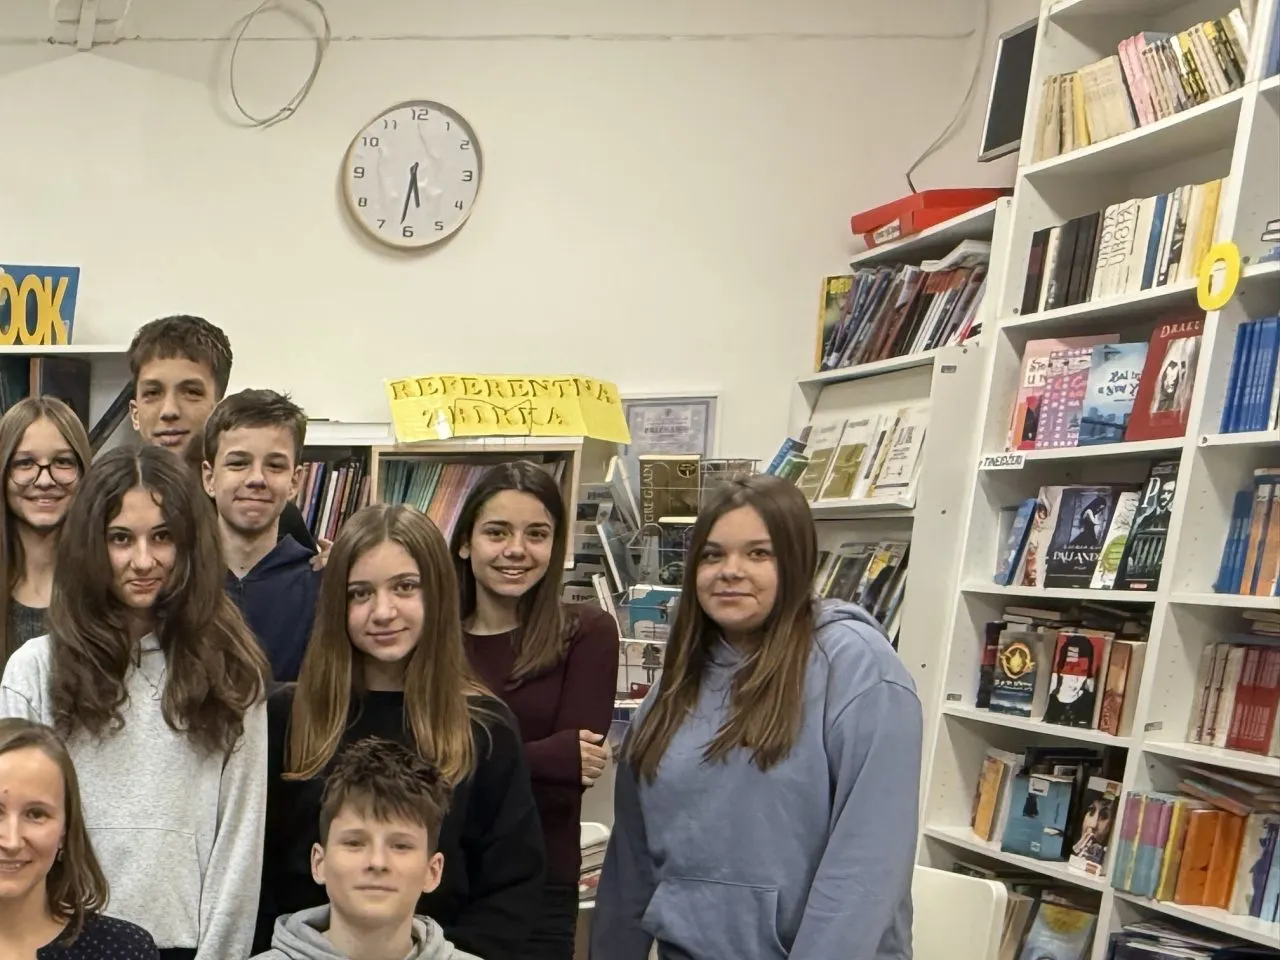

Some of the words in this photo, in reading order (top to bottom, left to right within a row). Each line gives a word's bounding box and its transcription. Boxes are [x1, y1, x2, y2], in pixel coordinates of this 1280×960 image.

[411, 109, 428, 120] 12
[384, 120, 397, 129] 11
[362, 137, 379, 147] 10
[460, 140, 470, 150] 2
[353, 167, 365, 179] 9
[462, 170, 472, 182] 3
[358, 197, 367, 207] 8
[455, 200, 463, 210] 4
[377, 219, 386, 229] 7
[435, 221, 444, 231] 5
[403, 226, 414, 238] 6
